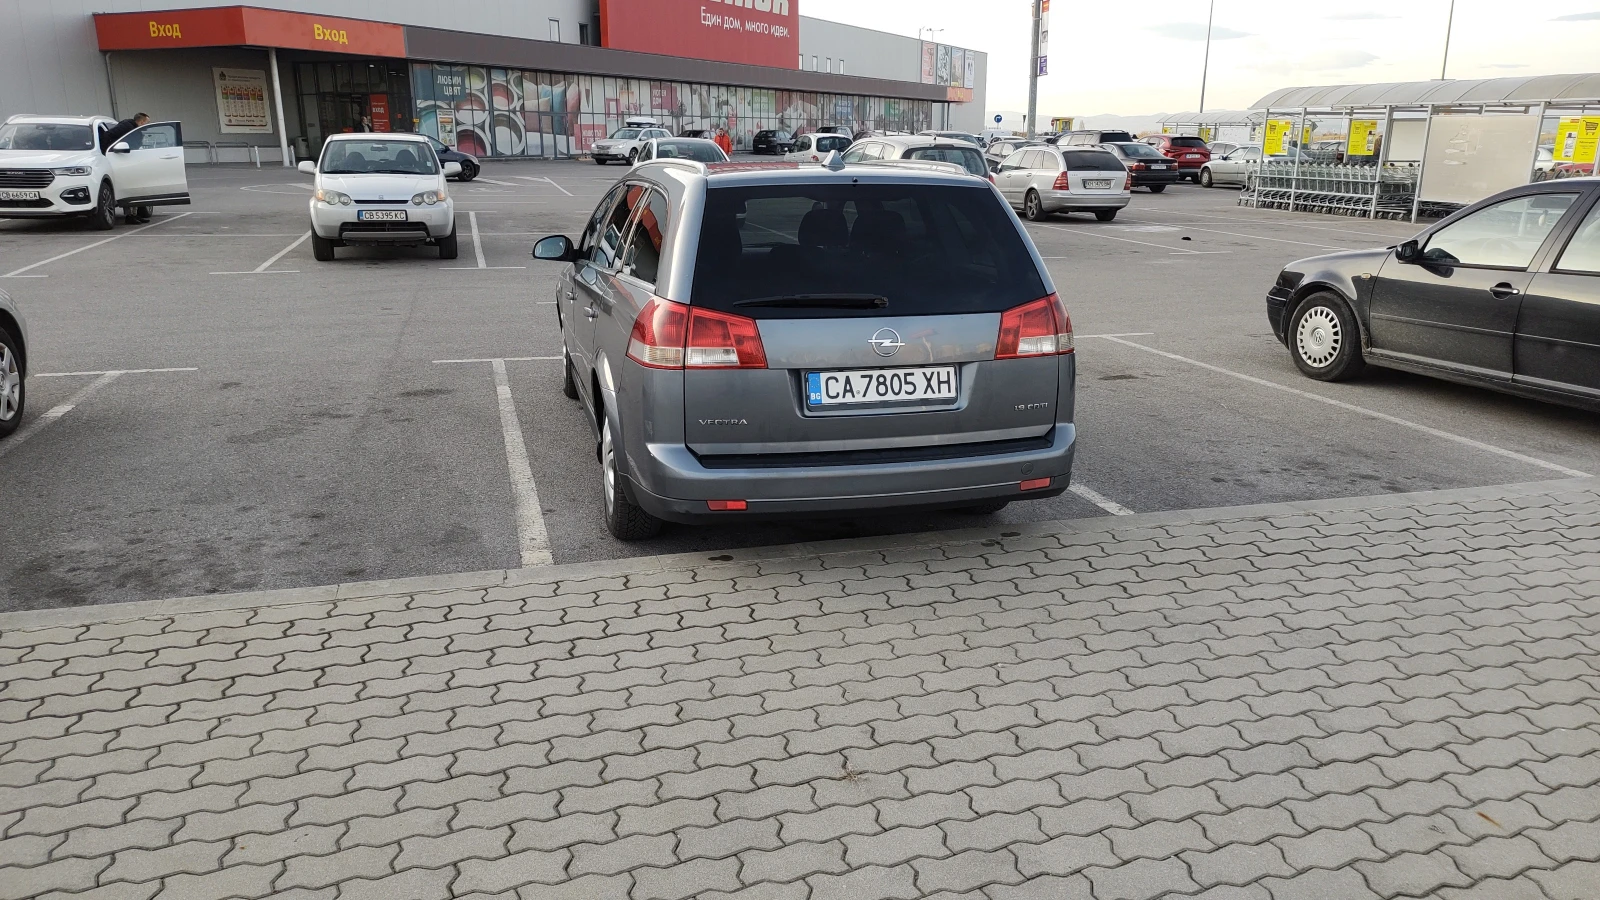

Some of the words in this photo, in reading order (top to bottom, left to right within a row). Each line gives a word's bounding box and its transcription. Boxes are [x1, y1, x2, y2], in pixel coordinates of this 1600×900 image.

[700, 6, 722, 27] Един
[723, 16, 743, 33] дом,
[745, 20, 769, 34] много
[770, 24, 790, 38] идеи.
[149, 21, 182, 38] Вход
[313, 23, 348, 44] Вход
[437, 75, 462, 85] ЛЮБИМ
[443, 86, 461, 97] ЦВЯТ
[375, 211, 394, 220] 5395
[825, 375, 856, 399] CA
[860, 372, 917, 398] 7805
[921, 371, 952, 395] XH
[810, 392, 821, 400] BG
